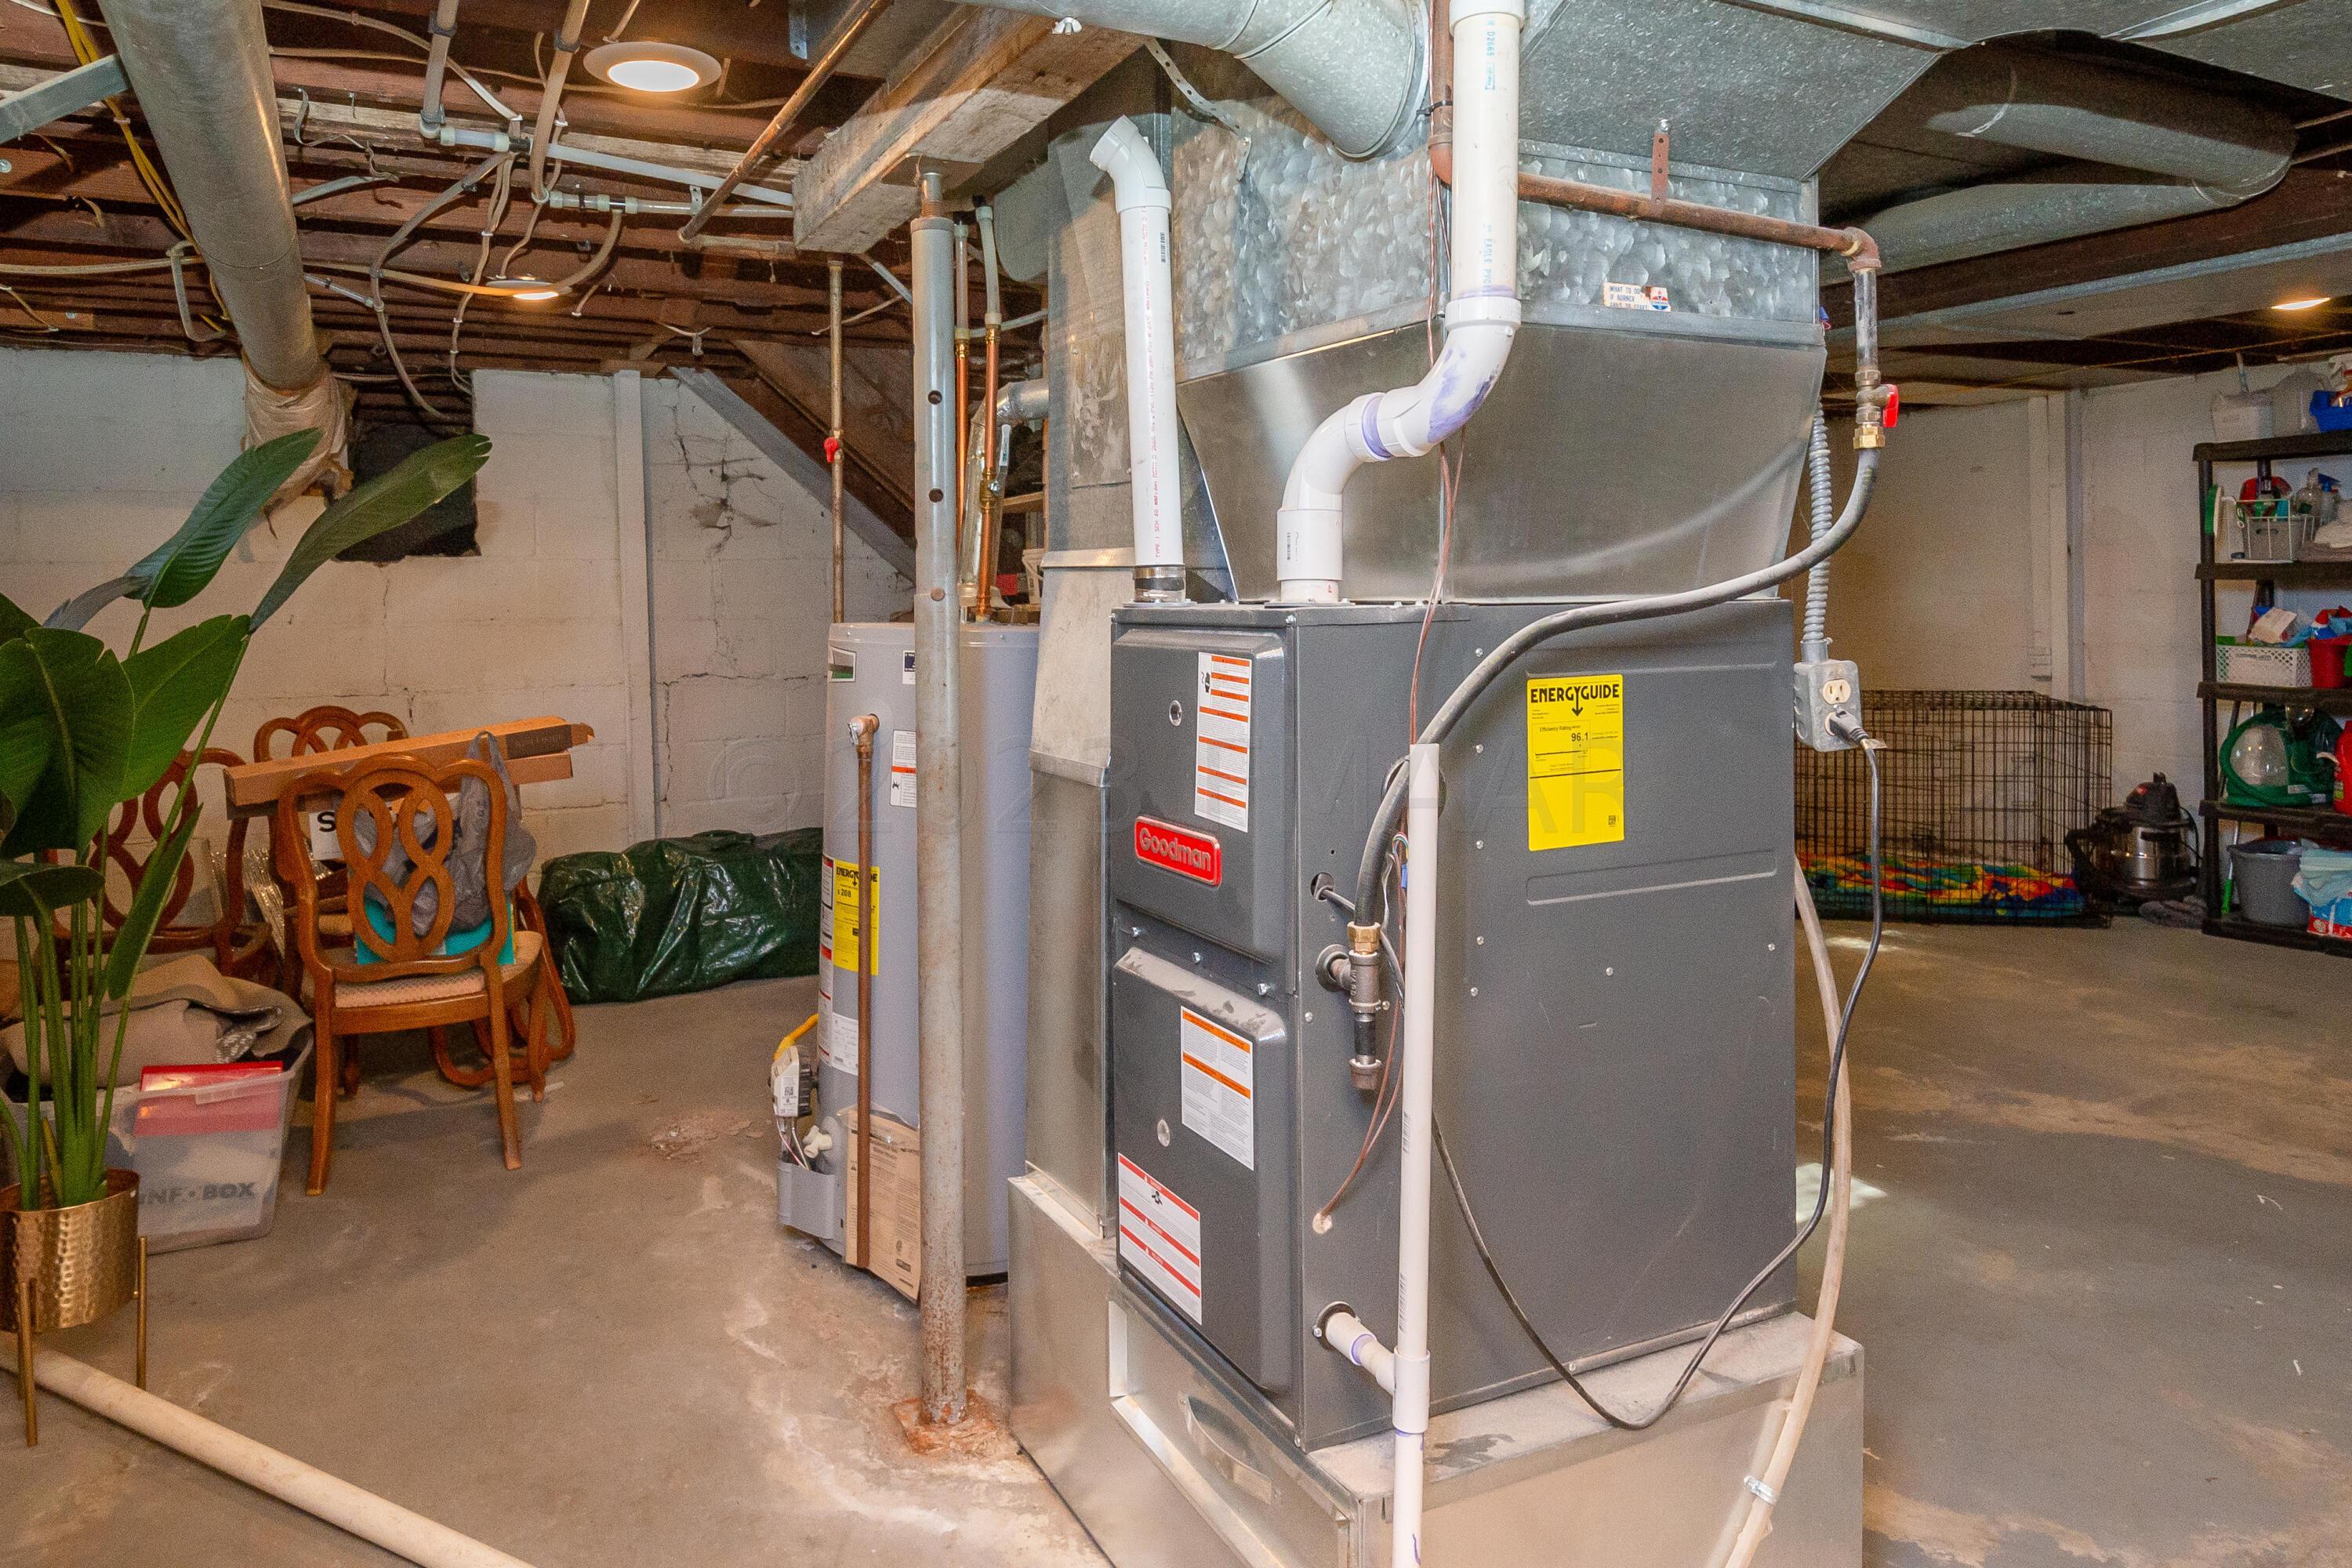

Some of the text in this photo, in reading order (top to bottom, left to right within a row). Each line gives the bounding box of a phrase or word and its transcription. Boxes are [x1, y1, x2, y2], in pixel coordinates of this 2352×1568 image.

[1530, 684, 1620, 703] ENERGYGUIDE
[1571, 731, 1588, 742] 96.1
[1139, 827, 1211, 872] Goodman
[201, 1181, 256, 1200] BOX
